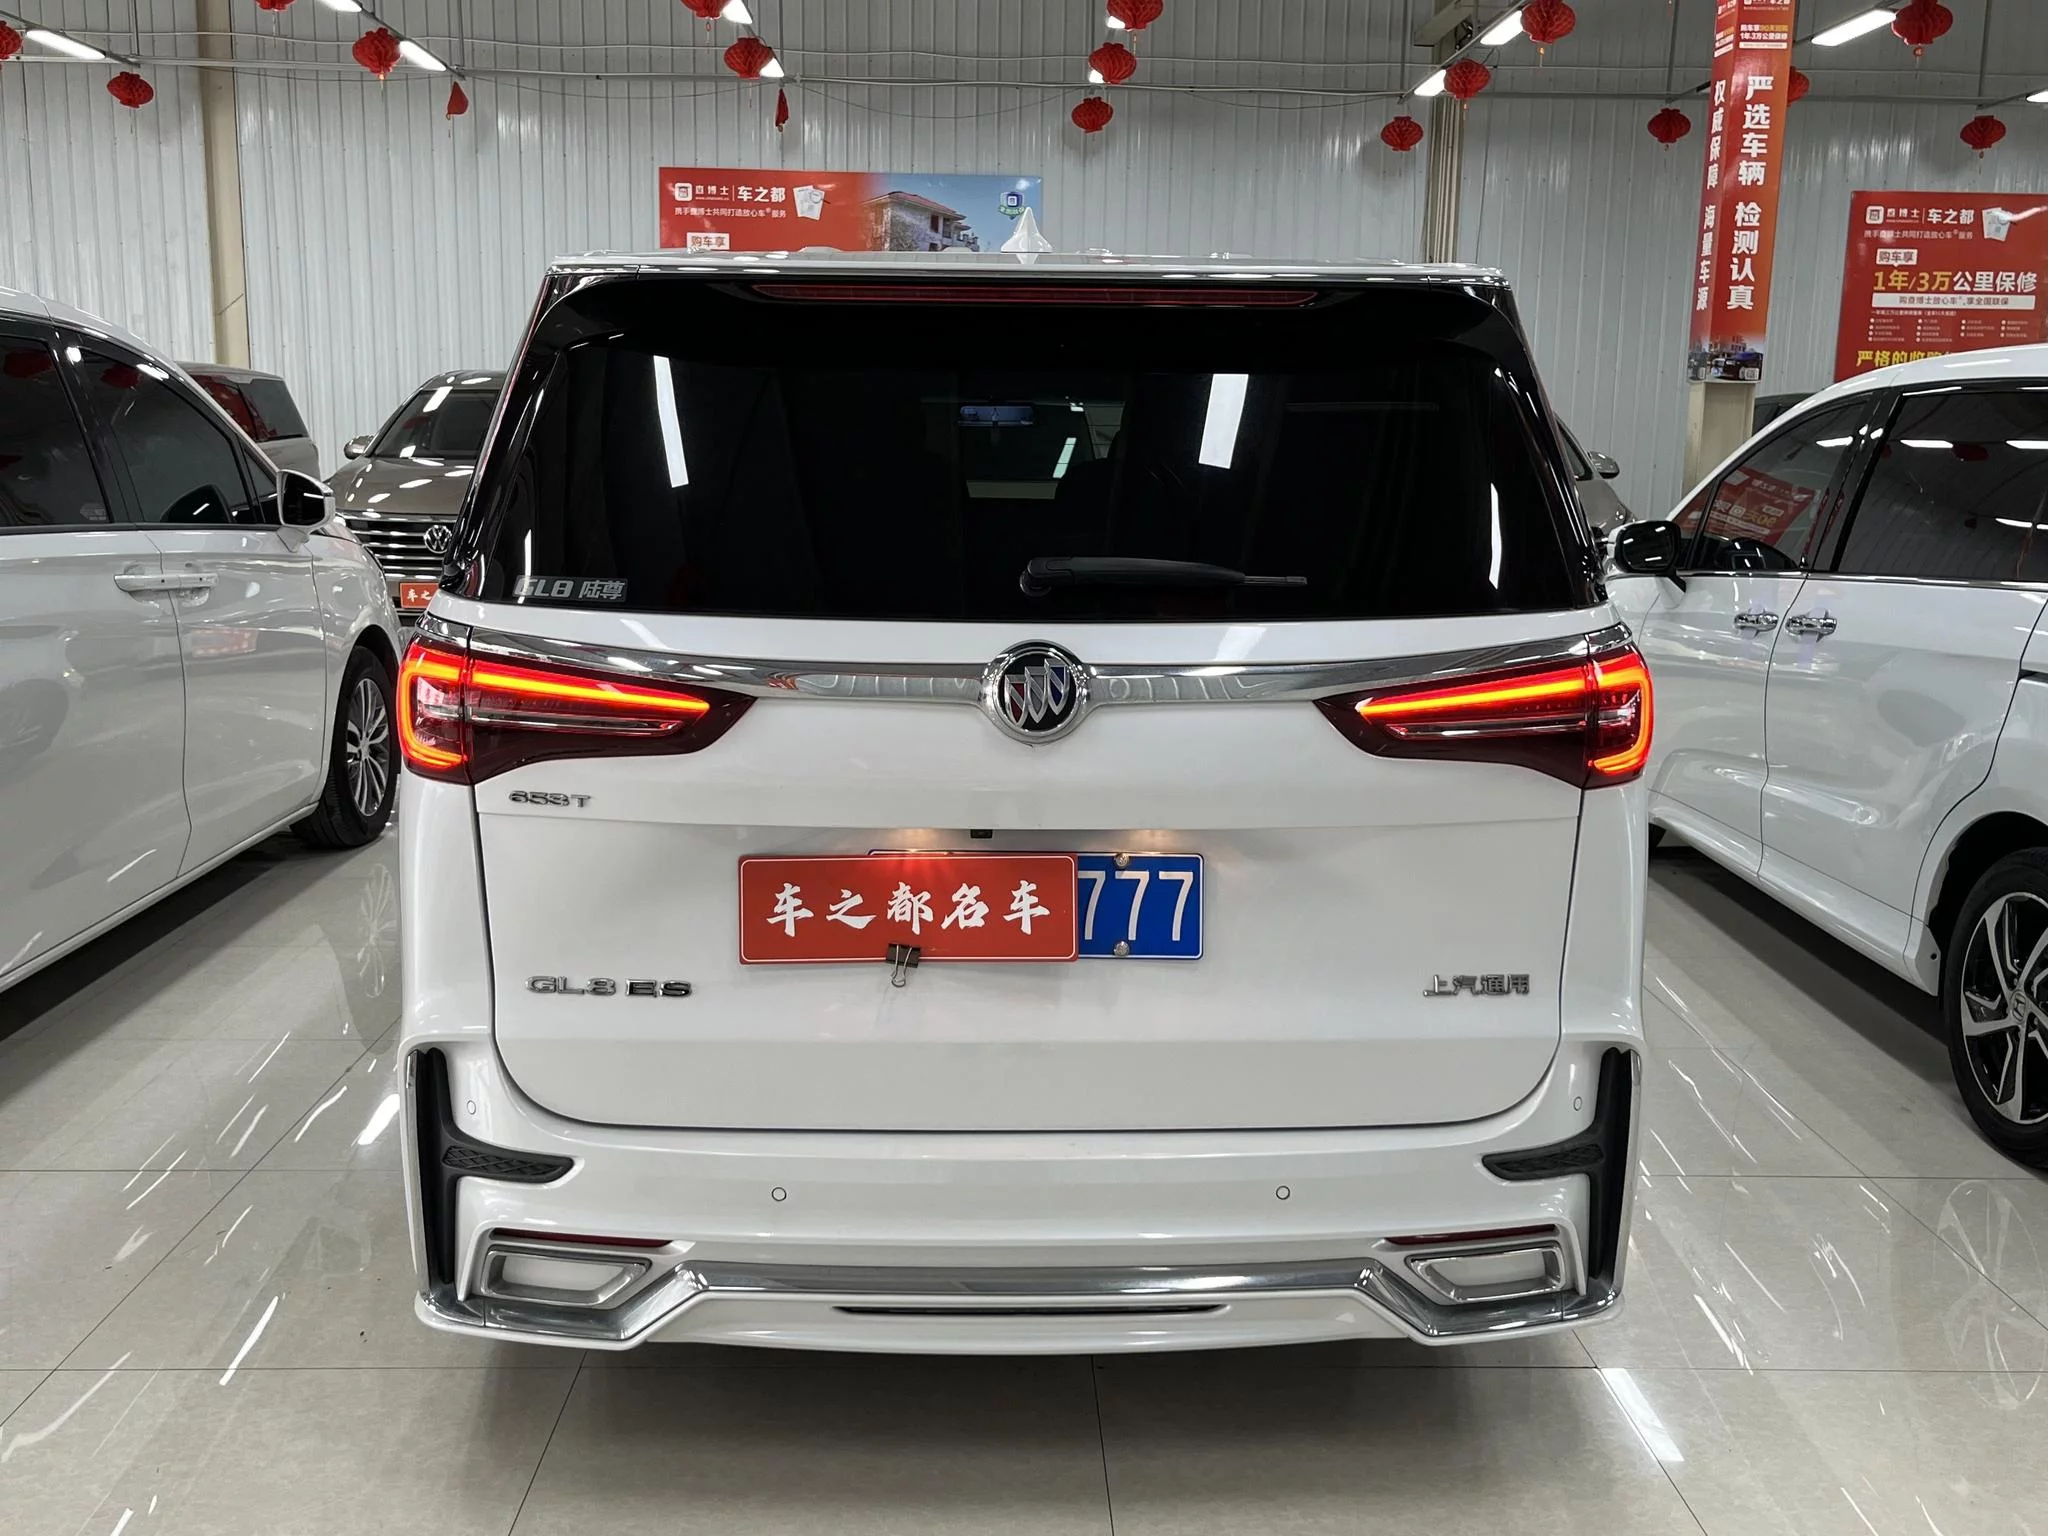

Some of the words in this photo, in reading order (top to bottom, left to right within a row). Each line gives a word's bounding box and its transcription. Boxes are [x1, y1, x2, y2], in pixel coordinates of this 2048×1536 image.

[1706, 79, 1726, 190] 权威保障
[1737, 75, 1774, 186] 严选车辆
[737, 185, 786, 203] 车之都
[1927, 208, 1975, 225] 车之都
[1696, 204, 1716, 311] 海量车源
[1727, 201, 1762, 311] 检测认真
[1879, 251, 1914, 263] 购车享
[1873, 270, 2037, 294] 1年/3万公里保修
[578, 579, 626, 600] 陆尊
[765, 881, 1051, 938] 车之都名车
[525, 975, 617, 996] GL8
[625, 978, 693, 998] ES
[1423, 973, 1530, 997] 上汽通用
